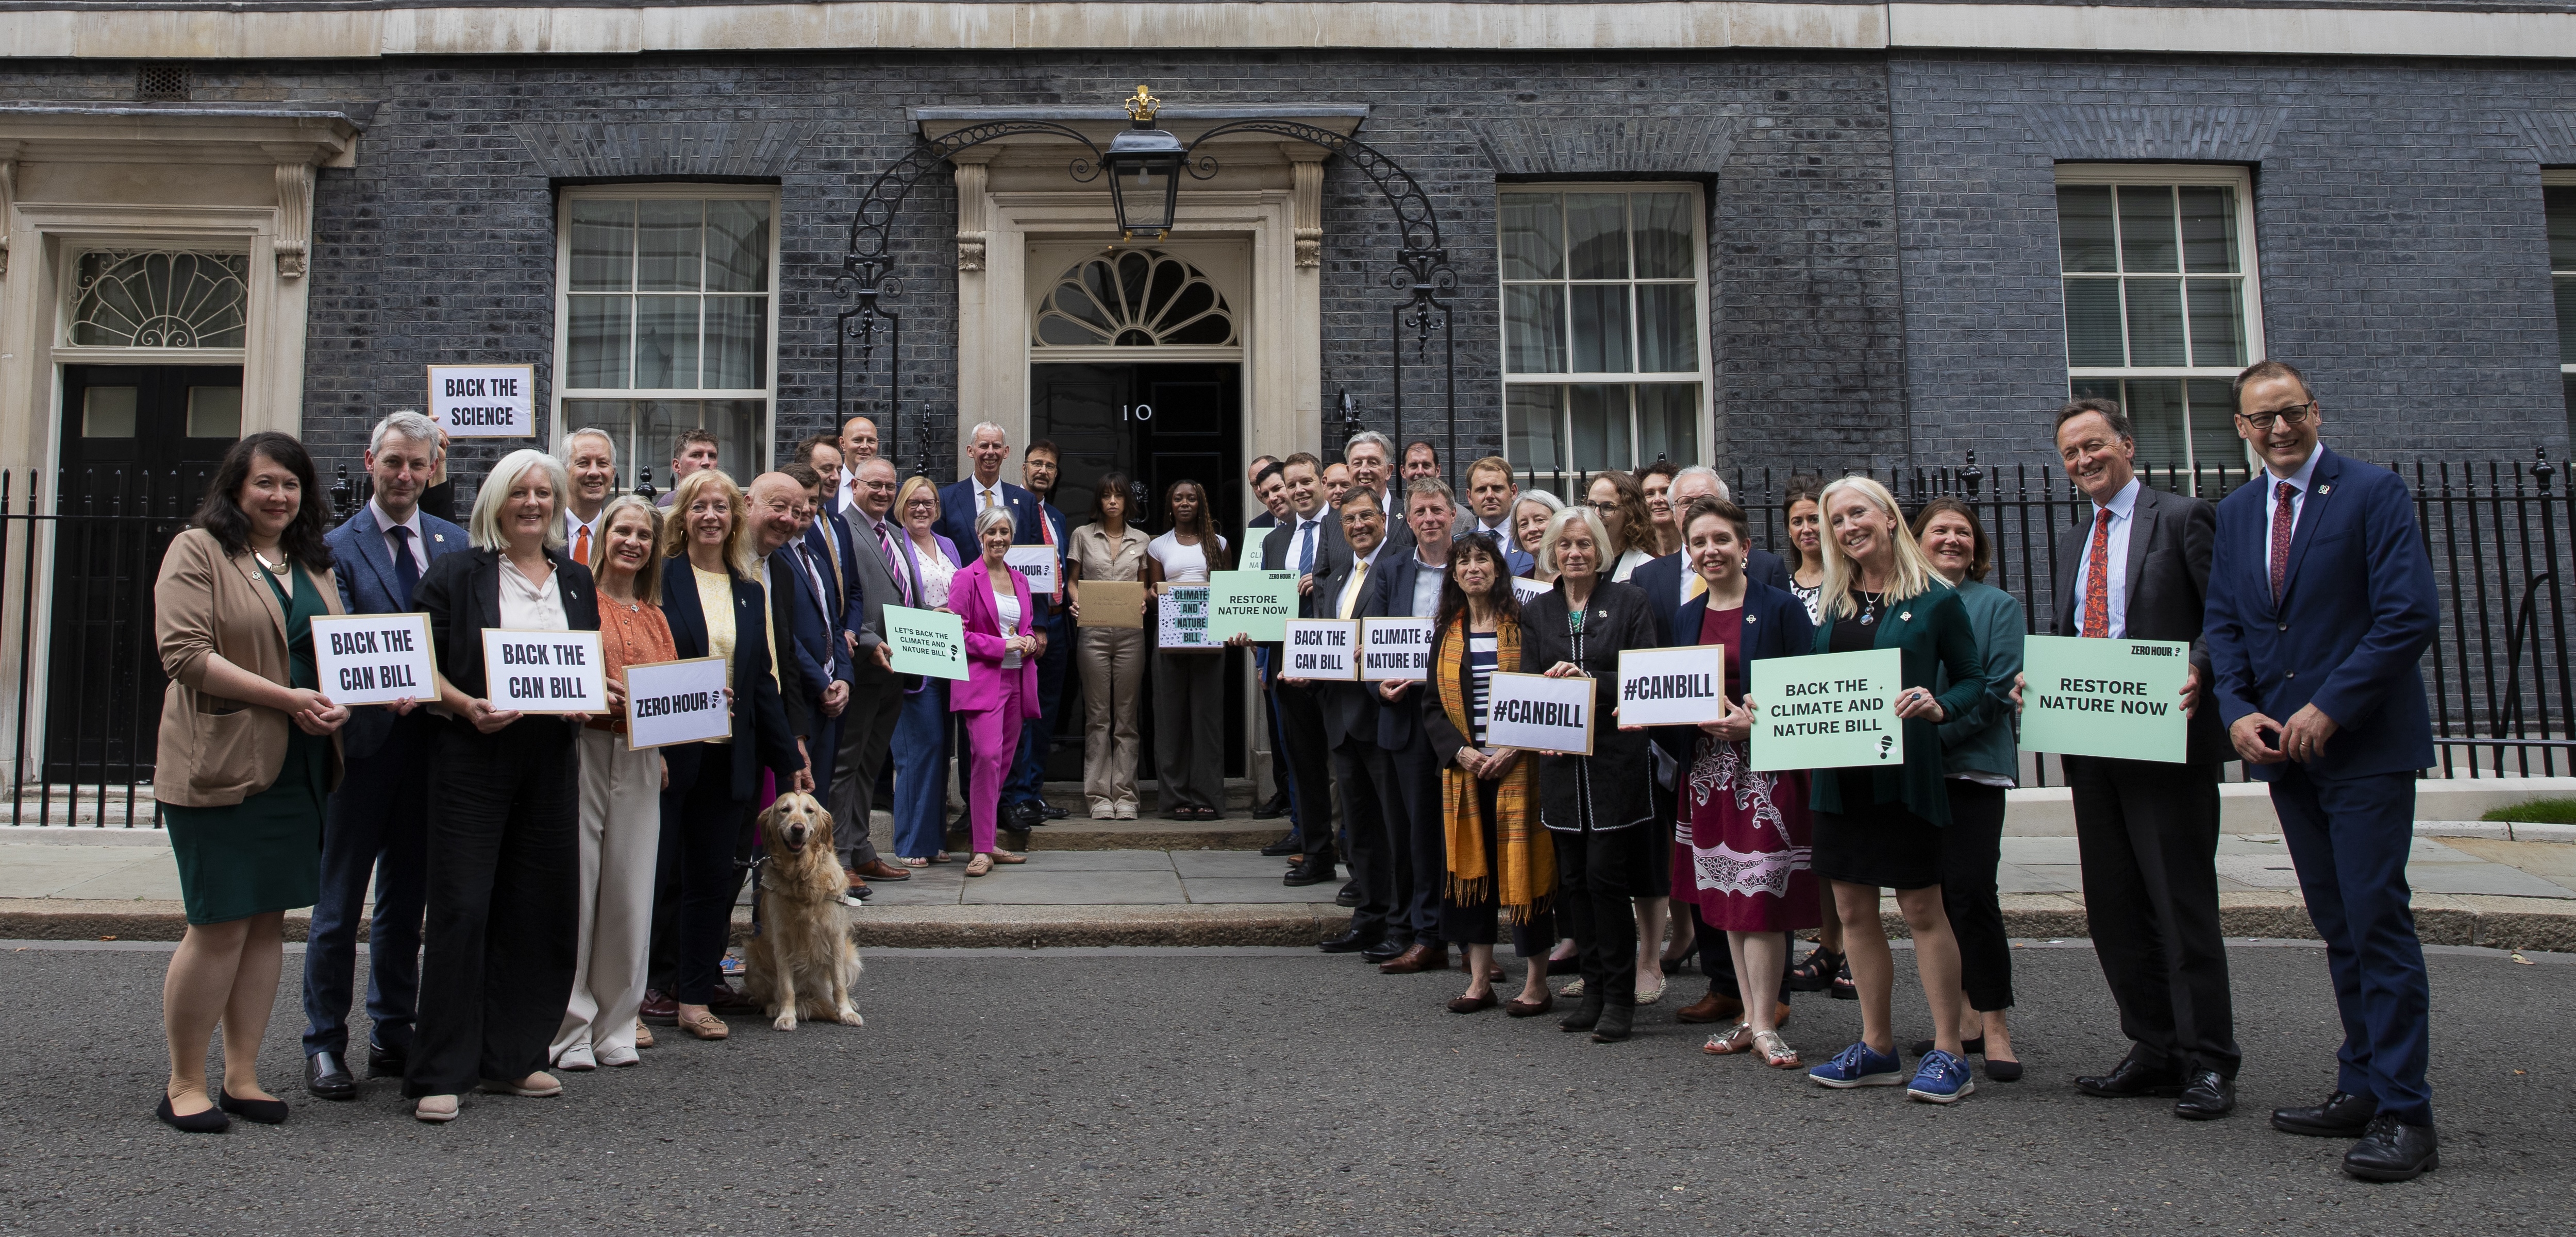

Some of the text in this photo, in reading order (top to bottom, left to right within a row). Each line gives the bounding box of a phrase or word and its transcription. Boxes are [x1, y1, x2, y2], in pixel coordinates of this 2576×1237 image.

[446, 379, 517, 397] BACK THE
[451, 407, 513, 426] SCIENCE
[1124, 404, 1152, 421] 10
[1018, 565, 1042, 576] HOUR
[1175, 590, 1208, 600] CLIMATE
[1182, 604, 1198, 613] AND
[1177, 618, 1206, 628] NATURE
[330, 630, 413, 655] BACK THE
[900, 637, 930, 646] CLIMATE
[1183, 633, 1200, 642] BILL
[1295, 631, 1346, 646] BACK THE
[1371, 629, 1421, 645] CLIMATE
[503, 644, 585, 665] BACK THE
[902, 646, 929, 654] NATURE
[2131, 646, 2172, 656] ZERO HOUR
[1296, 654, 1343, 670] CAN BILL
[1367, 652, 1428, 669] NATURE BIL
[340, 665, 416, 690] CAN BILL
[509, 677, 586, 698] CAN BILL
[1625, 674, 1714, 700] #CANBILL
[1786, 679, 1867, 696] BACK THE
[2061, 679, 2147, 696] RESTORE
[637, 692, 708, 718] ZERO HOUR
[1771, 698, 1883, 717] CLIMATE AND
[2040, 696, 2168, 716] NATURE NOW
[1494, 700, 1583, 728] #CANBILL
[1774, 719, 1882, 737] NATURE BILL
